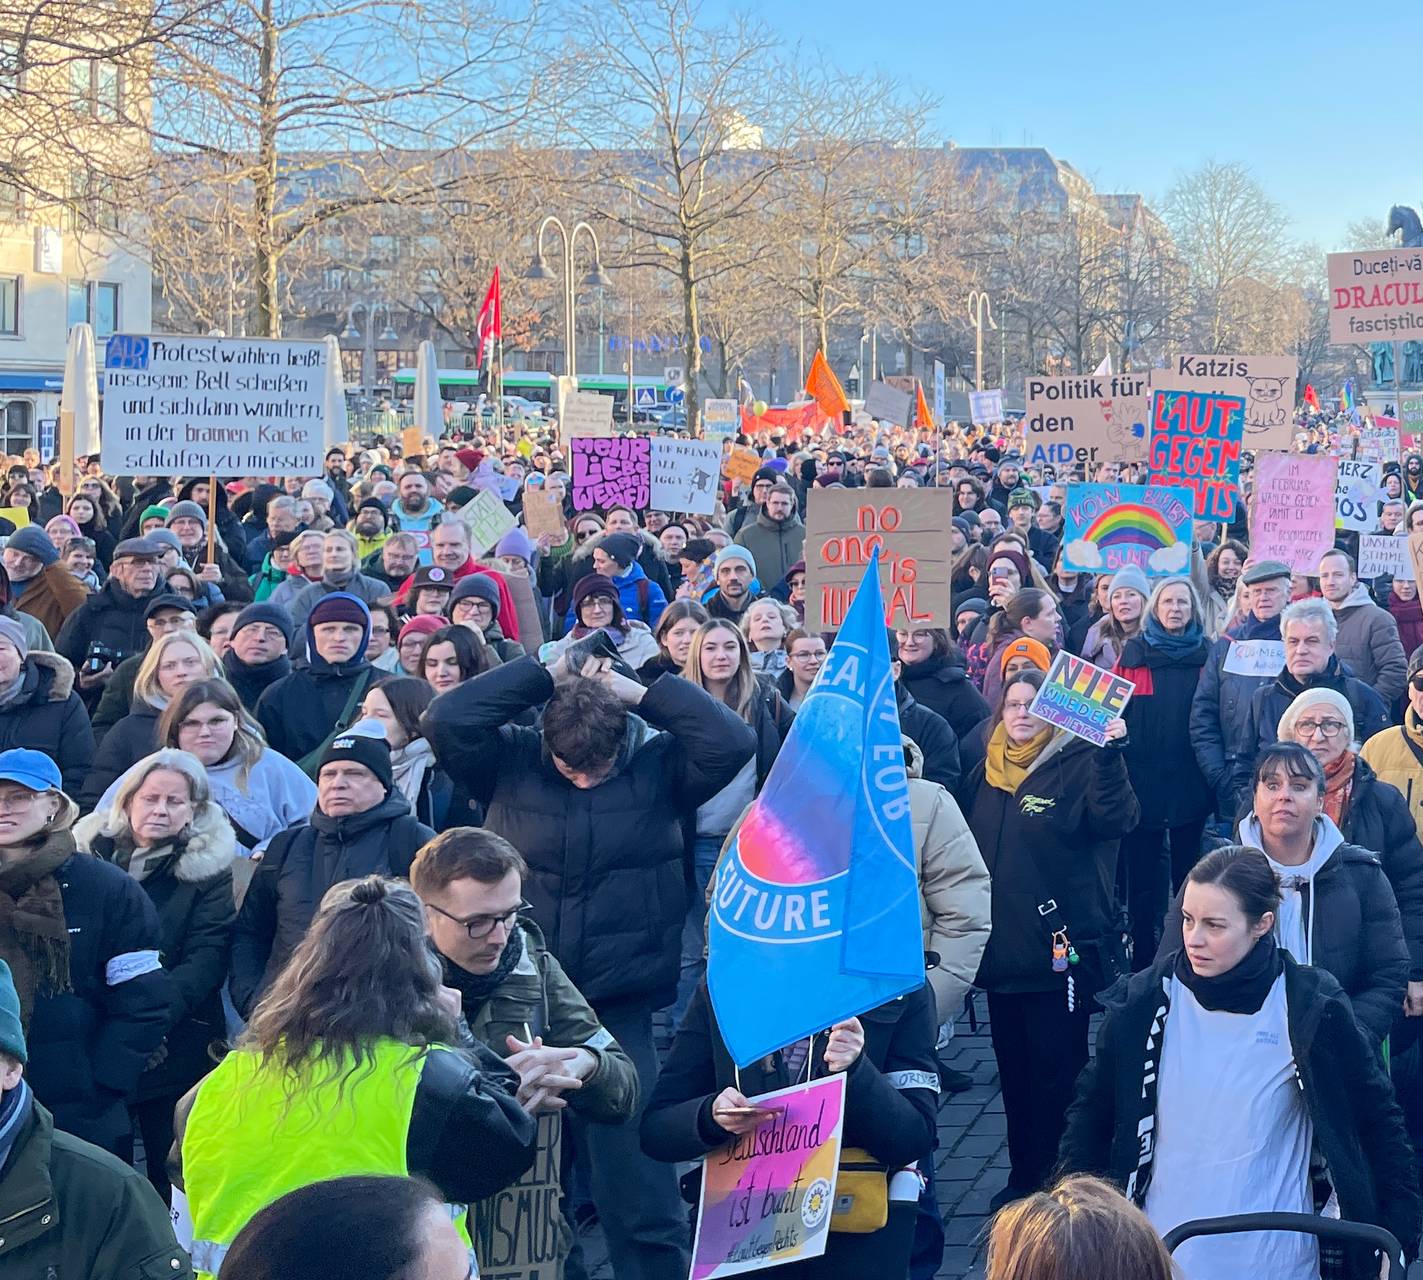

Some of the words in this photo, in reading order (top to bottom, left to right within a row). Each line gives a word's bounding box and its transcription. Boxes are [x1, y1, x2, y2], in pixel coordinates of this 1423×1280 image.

[1353, 254, 1422, 277] Duceți-vă
[1178, 356, 1249, 378] Katzis
[195, 370, 231, 391] Bett
[236, 372, 308, 393] scheißen
[1029, 380, 1104, 401] Politik
[1111, 376, 1145, 398] für
[122, 397, 154, 416] und
[159, 396, 193, 417] sich
[195, 396, 238, 417] dann
[1153, 393, 1242, 438] LAUT
[125, 425, 141, 442] in
[147, 422, 176, 442] der
[185, 423, 249, 444] braunen
[257, 424, 309, 444] Kacke
[1030, 413, 1074, 432] den
[125, 449, 210, 469] schlafen
[215, 454, 241, 469] zu
[247, 450, 315, 469] müssen
[1031, 443, 1099, 464] AfDer
[1150, 432, 1241, 477] GEGEN
[1288, 463, 1299, 475] IM
[857, 503, 902, 533] no
[1070, 486, 1121, 528] KÖLN
[1142, 488, 1193, 528] BLEIBT
[821, 533, 892, 564] one
[1362, 536, 1400, 549] UNSERE
[890, 552, 917, 584] is
[1361, 550, 1404, 563] STIMME
[1048, 653, 1133, 715] NIE
[1037, 702, 1060, 720] IST
[1041, 686, 1114, 726] WIEDER
[714, 858, 832, 932] FUTURE
[728, 1169, 756, 1229] ist
[760, 1163, 805, 1220] bunt
